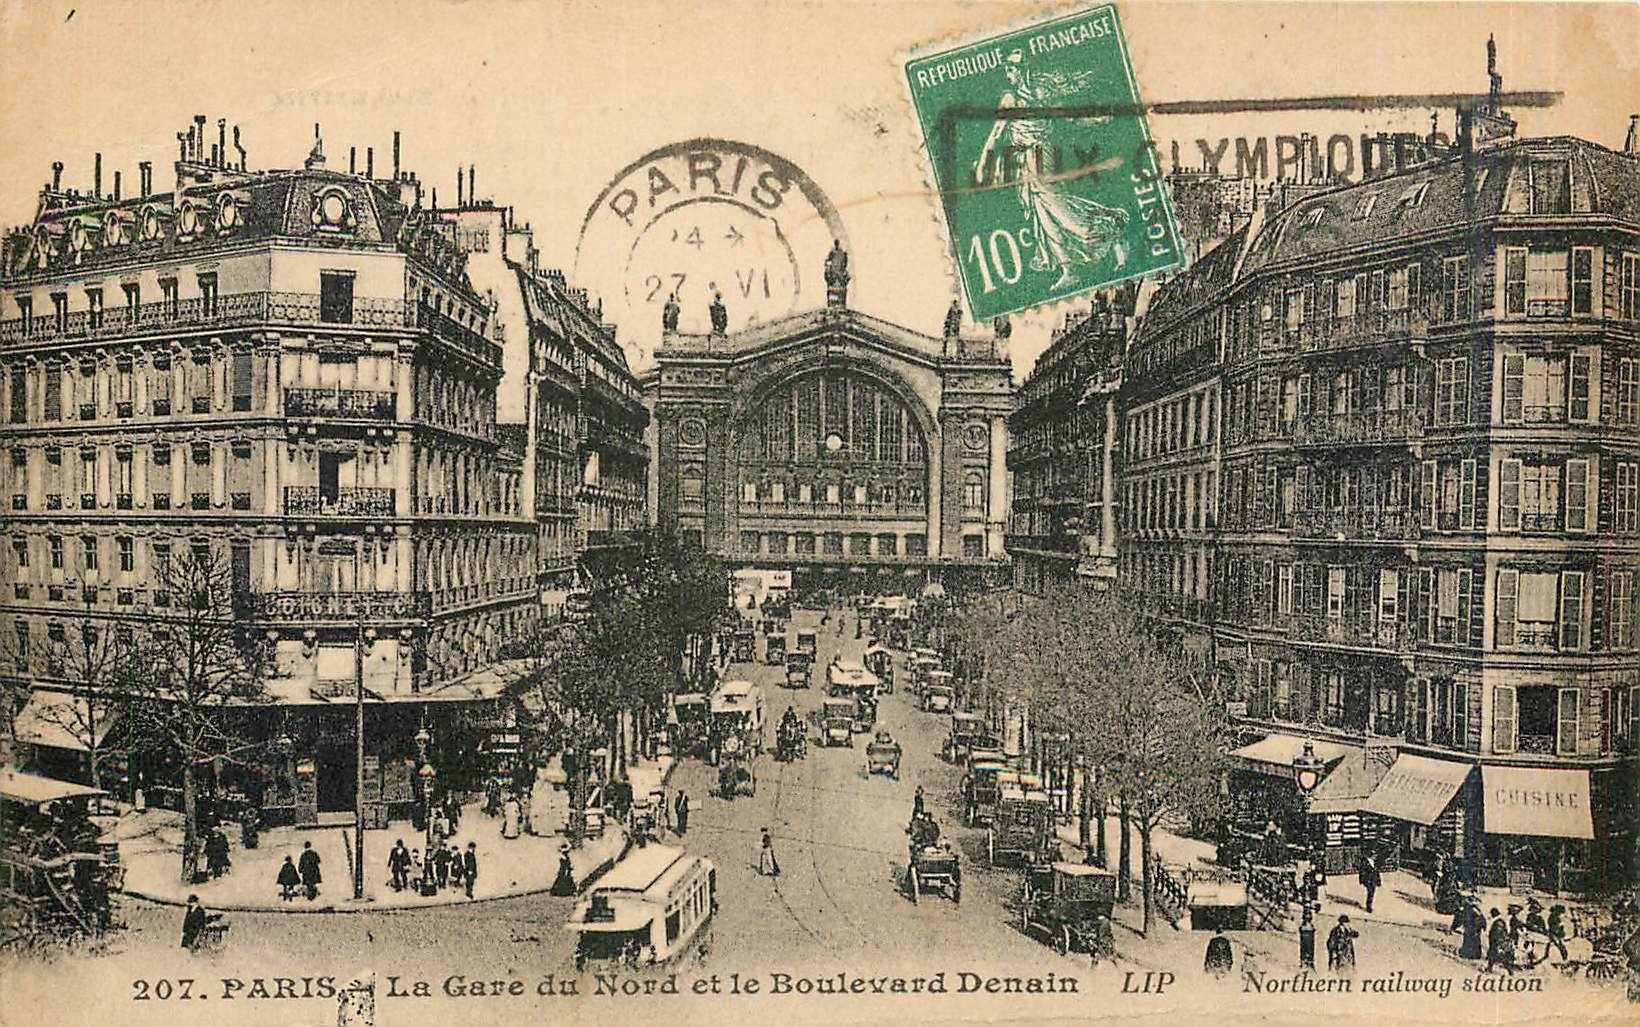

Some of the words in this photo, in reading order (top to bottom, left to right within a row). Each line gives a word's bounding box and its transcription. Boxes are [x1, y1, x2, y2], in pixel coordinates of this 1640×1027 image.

[609, 152, 792, 228] PARIS
[1130, 168, 1170, 257] POSTES
[645, 273, 687, 302] 27
[1496, 788, 1579, 809] CUISINE
